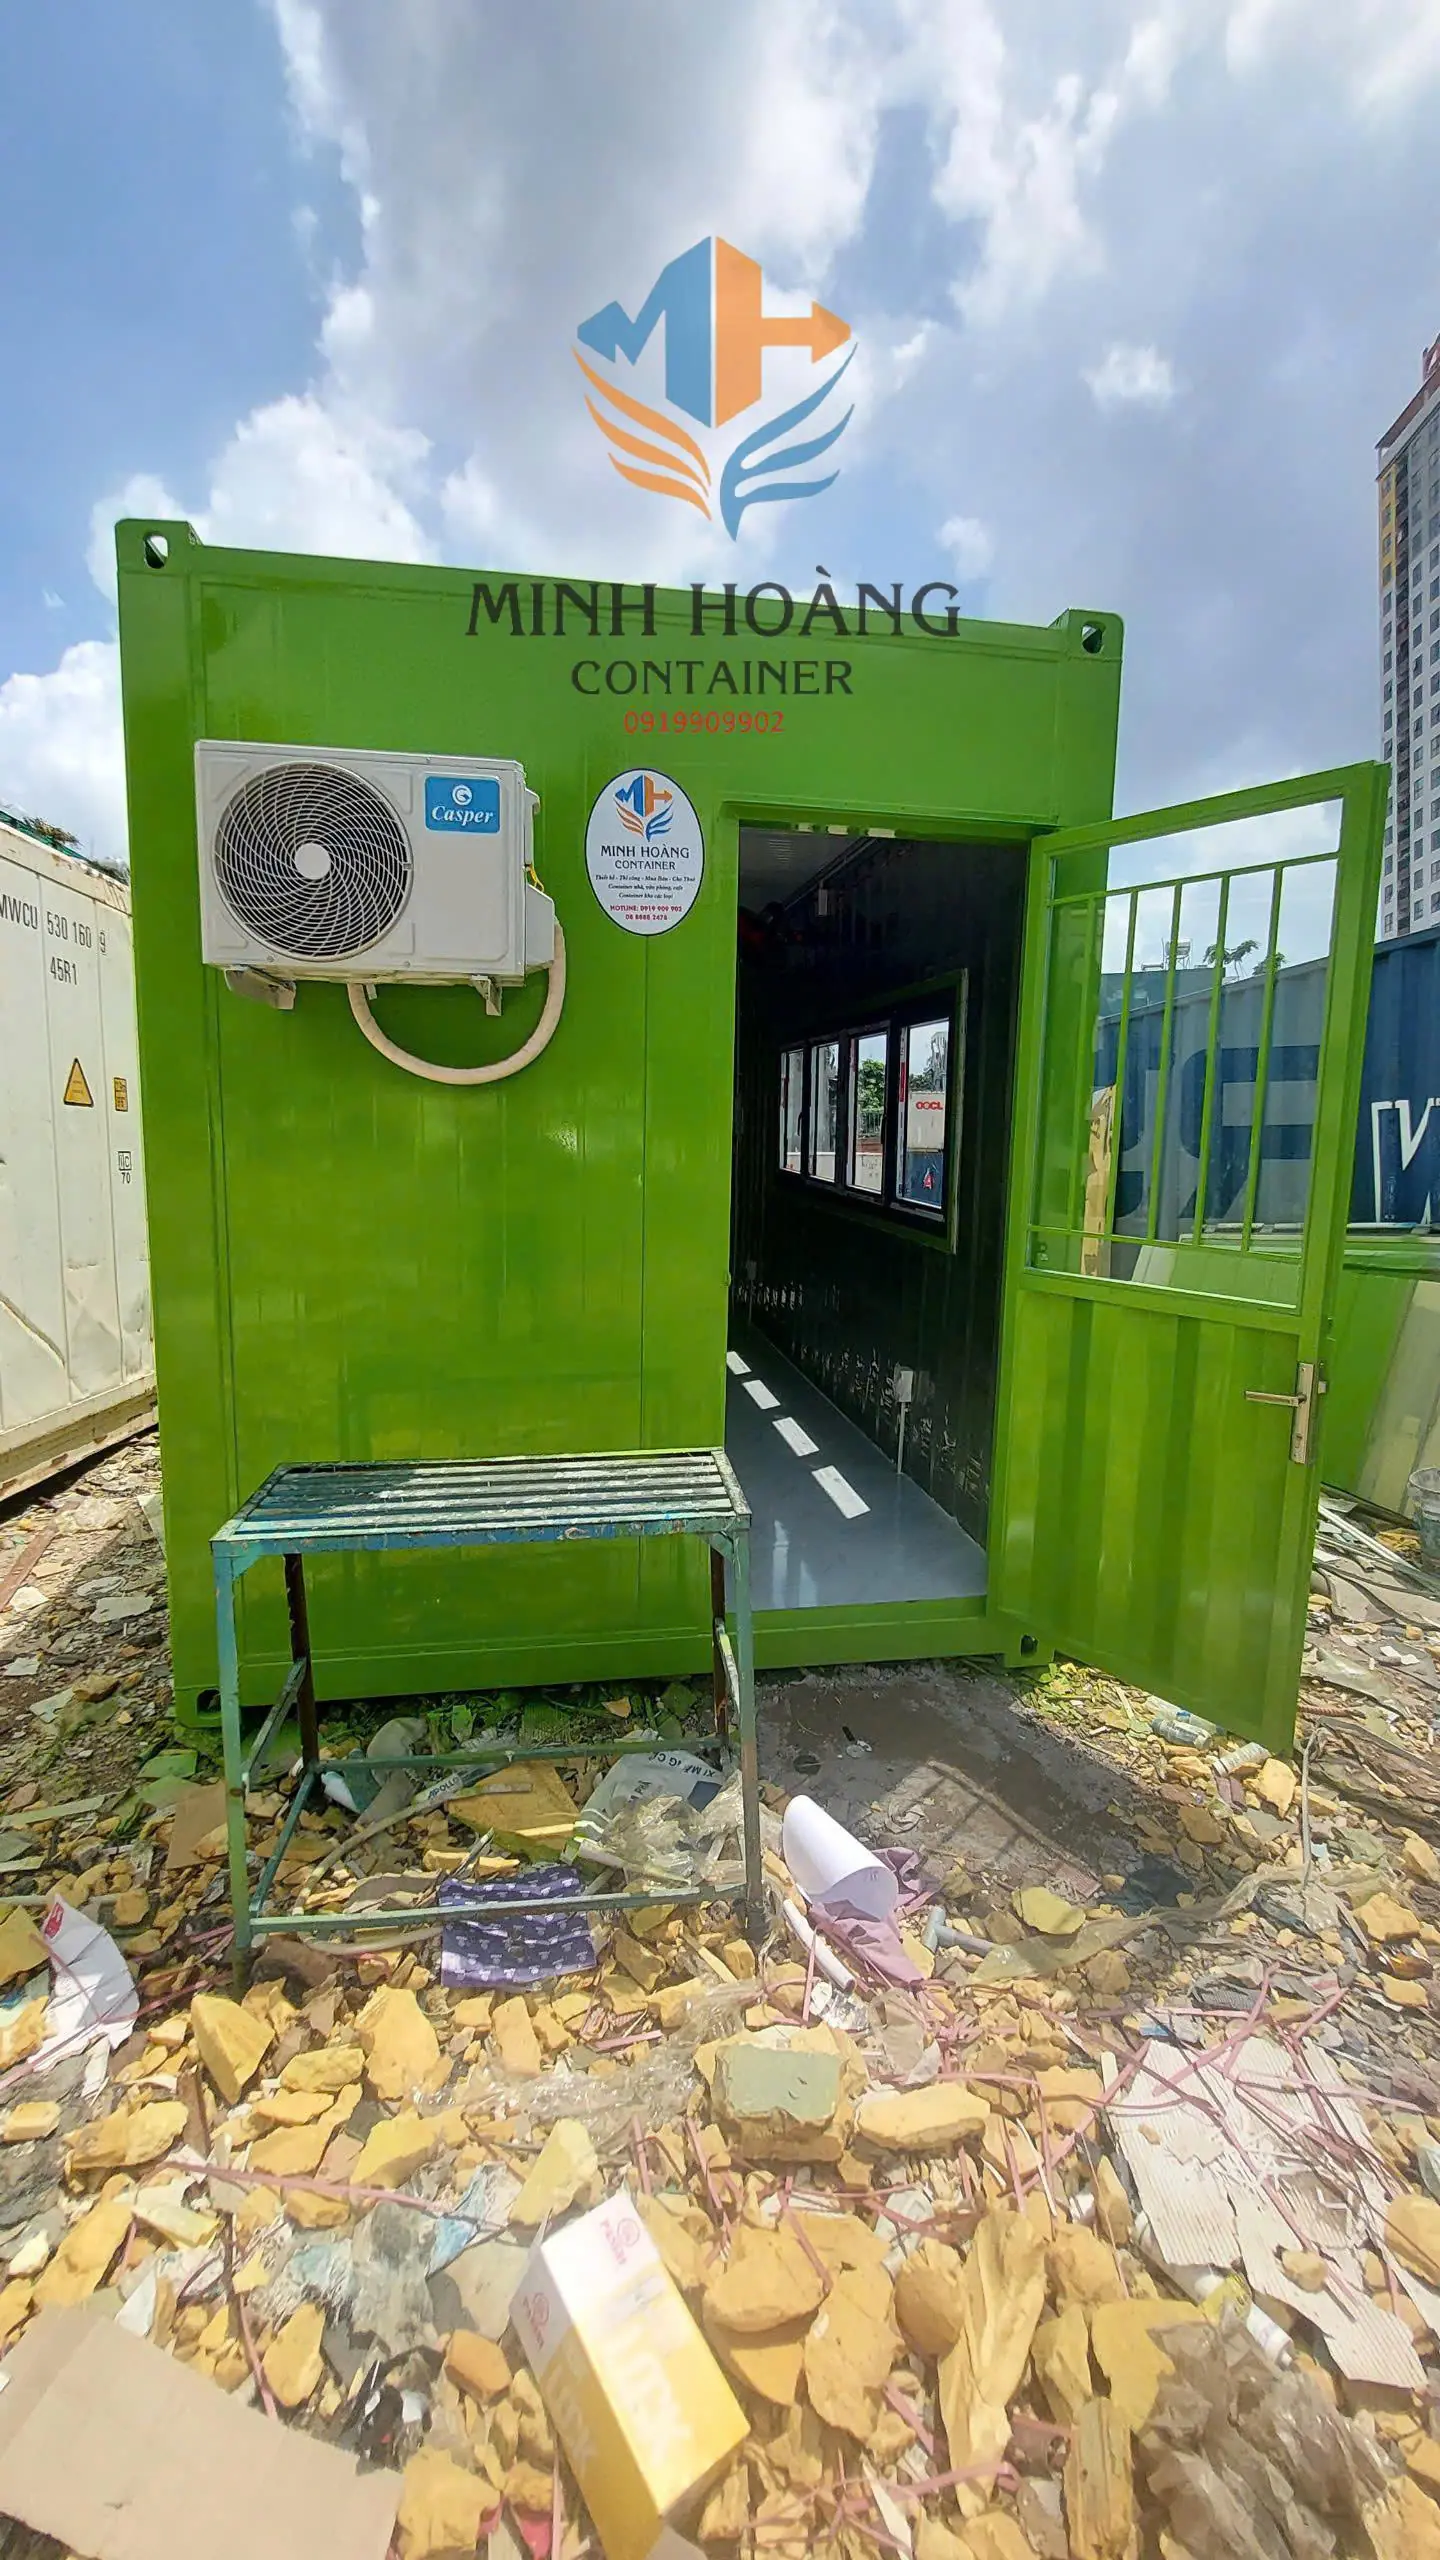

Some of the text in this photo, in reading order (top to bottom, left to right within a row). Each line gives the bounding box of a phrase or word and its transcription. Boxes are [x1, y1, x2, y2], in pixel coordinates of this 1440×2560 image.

[431, 805, 494, 826] Casper
[601, 843, 690, 859] MINH HOÀNG
[614, 860, 676, 870] CONTAINER
[0, 894, 39, 930] MWCU
[47, 911, 68, 940] 530
[72, 921, 92, 948] 160
[50, 956, 78, 985] 45R1
[915, 1101, 944, 1110] OOCL
[120, 1172, 131, 1185] 70
